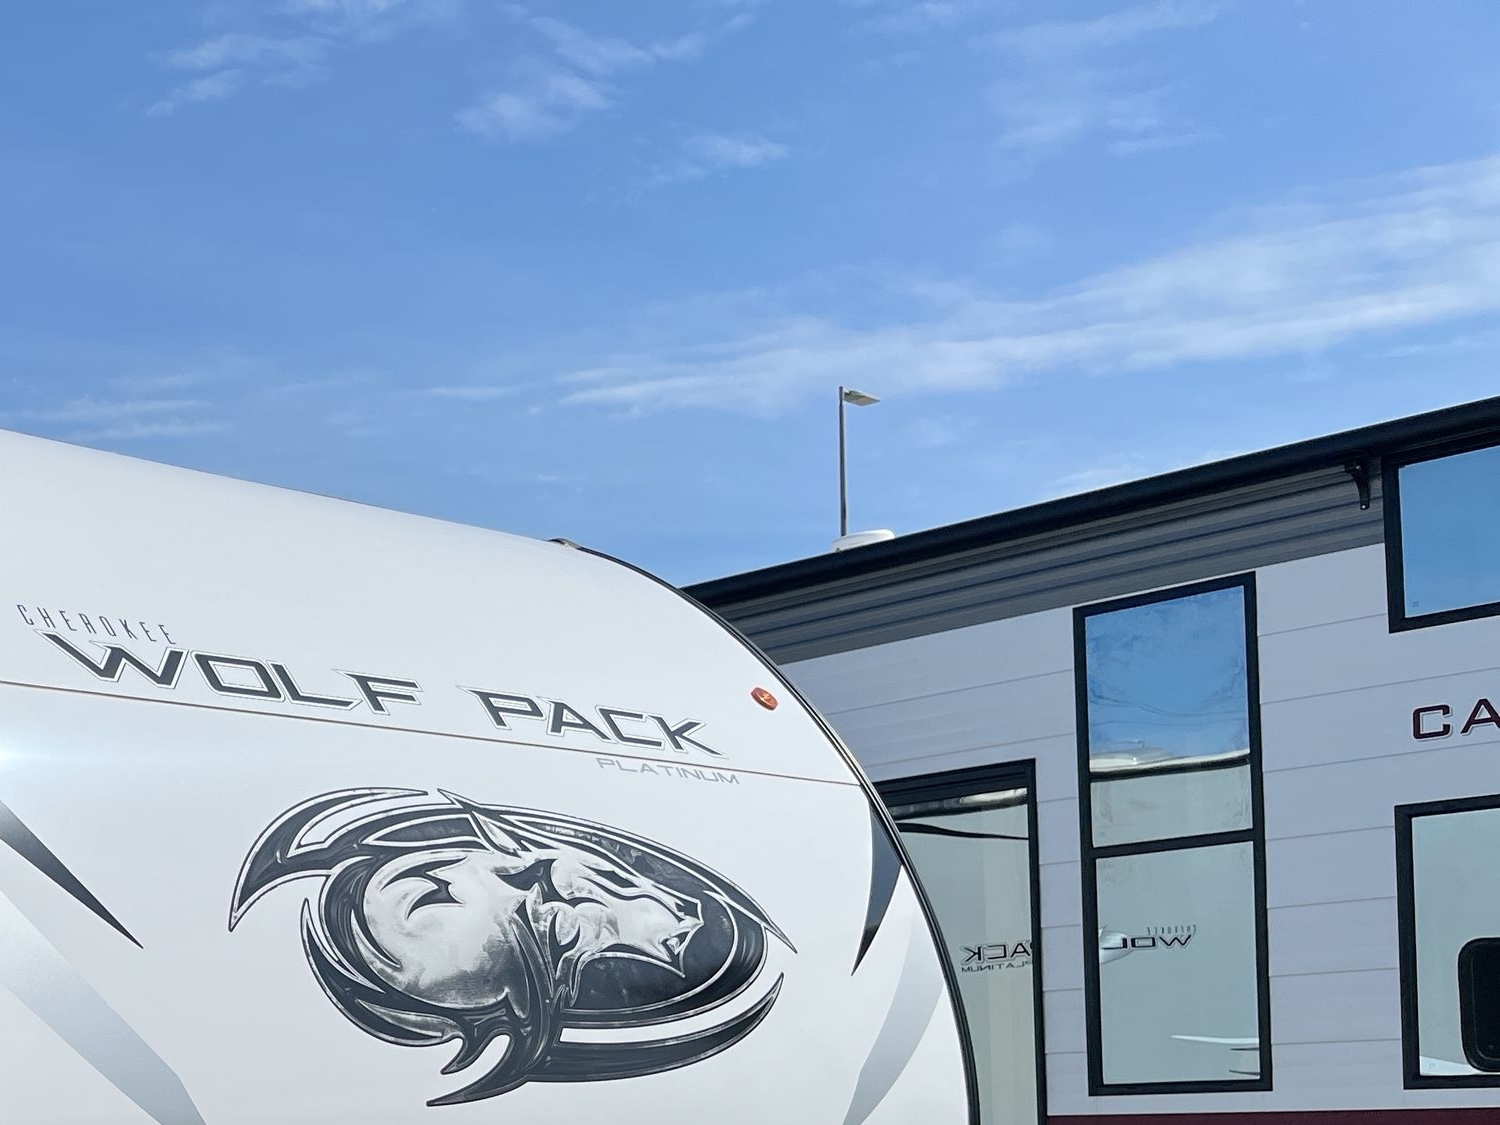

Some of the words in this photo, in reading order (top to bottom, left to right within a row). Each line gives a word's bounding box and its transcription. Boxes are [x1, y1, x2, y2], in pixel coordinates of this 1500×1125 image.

[16, 604, 176, 645] CHEROKEE
[34, 628, 423, 716] WOLF
[455, 684, 730, 760] PACK
[595, 757, 740, 785] PLATINUM
